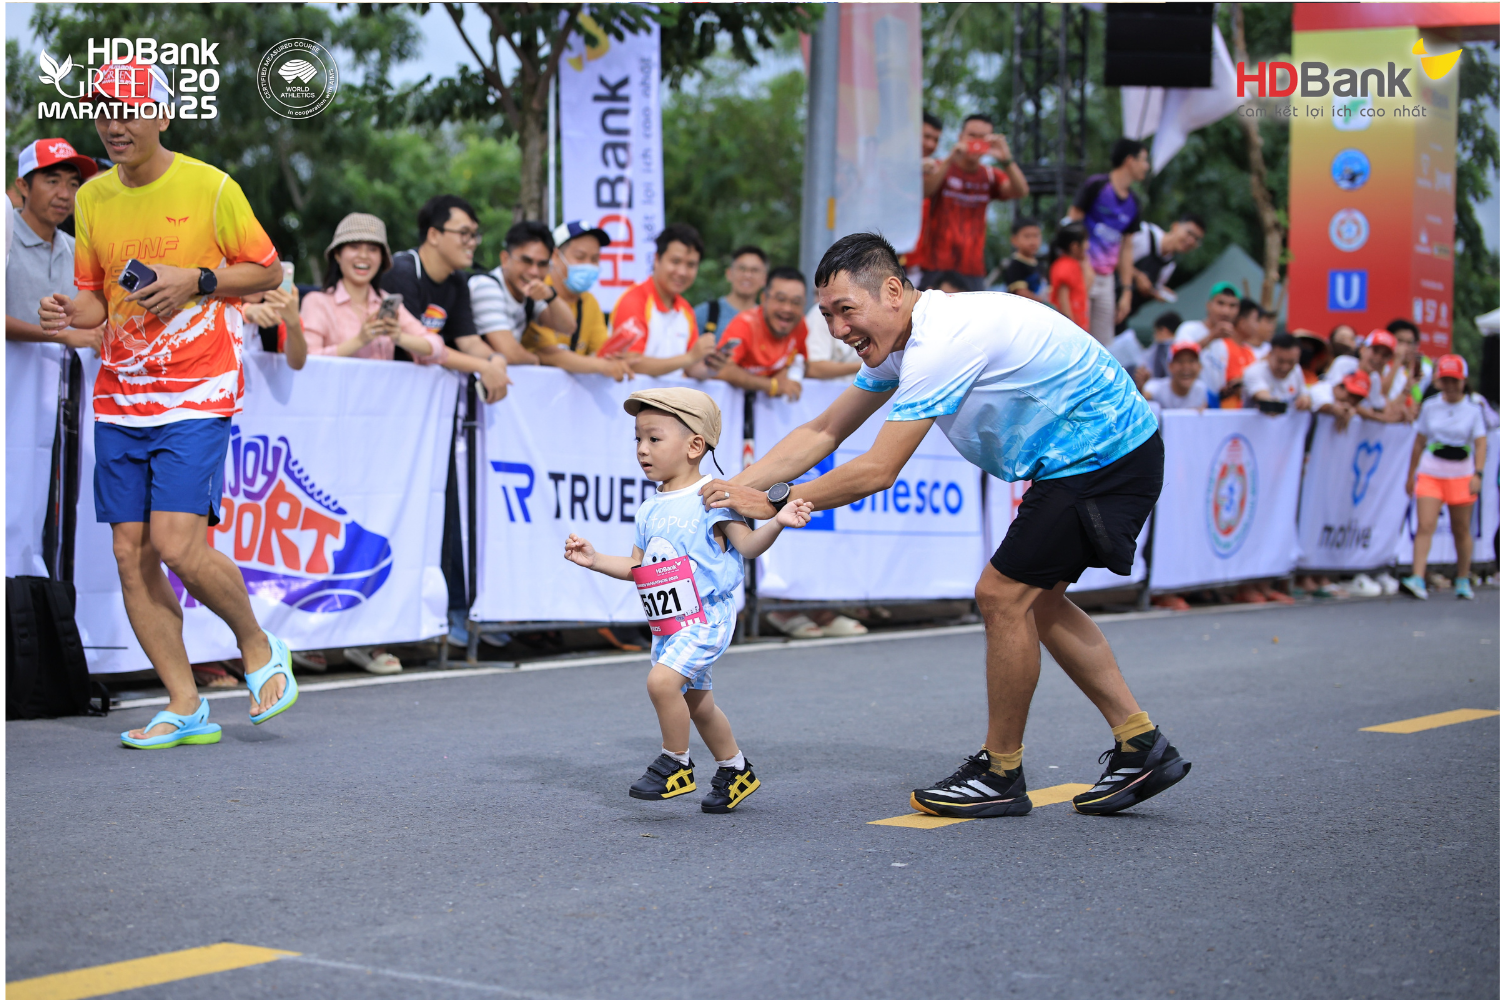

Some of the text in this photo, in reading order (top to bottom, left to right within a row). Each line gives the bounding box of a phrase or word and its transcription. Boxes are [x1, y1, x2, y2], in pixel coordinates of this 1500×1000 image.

[593, 74, 635, 287] HDBank
[206, 478, 341, 575] PORT
[655, 565, 678, 575] HDBank
